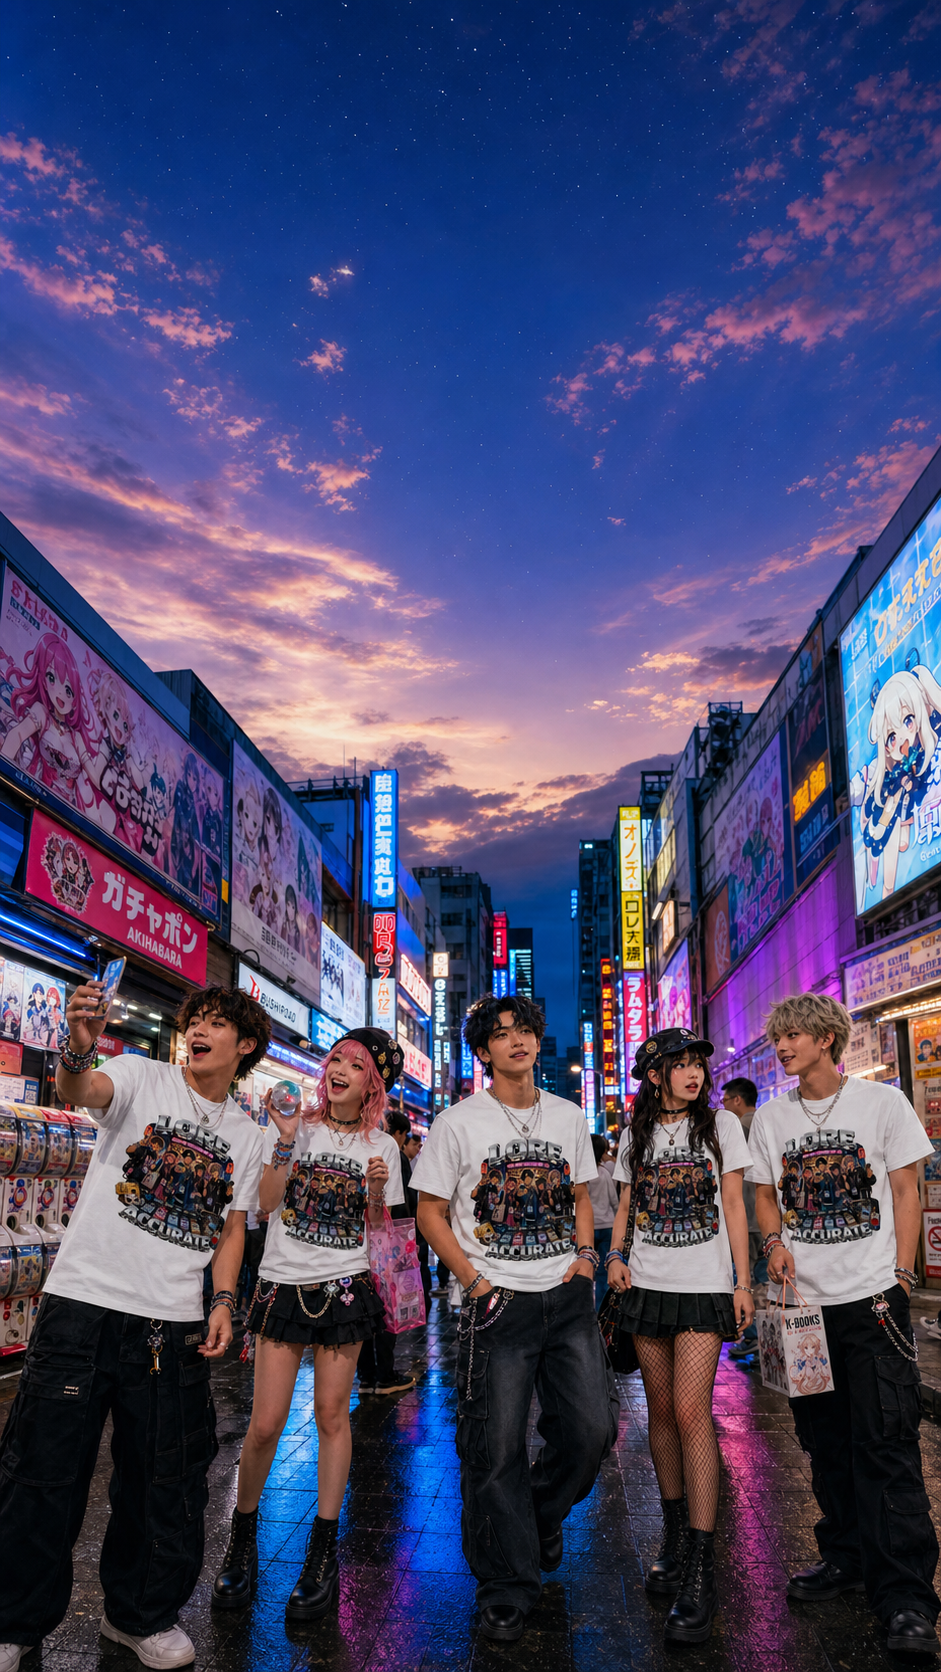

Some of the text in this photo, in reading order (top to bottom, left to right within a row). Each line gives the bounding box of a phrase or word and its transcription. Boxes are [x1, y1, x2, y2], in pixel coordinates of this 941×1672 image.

[102, 871, 198, 953] ガチャポン
[127, 926, 182, 969] AKIHABARA
[627, 977, 643, 1041] ラムタラ
[155, 1114, 231, 1160] LORE
[785, 1129, 857, 1159] LORE
[301, 1152, 363, 1176] LORE
[488, 1138, 563, 1168] LORE
[118, 1205, 211, 1253] ACCURATE
[285, 1225, 358, 1250] ACCURATE
[642, 1228, 714, 1249] ACCURATE
[791, 1222, 873, 1244] ACCURATE
[485, 1238, 575, 1261] ACCURATE
[785, 1314, 821, 1330] K-BOOKS
